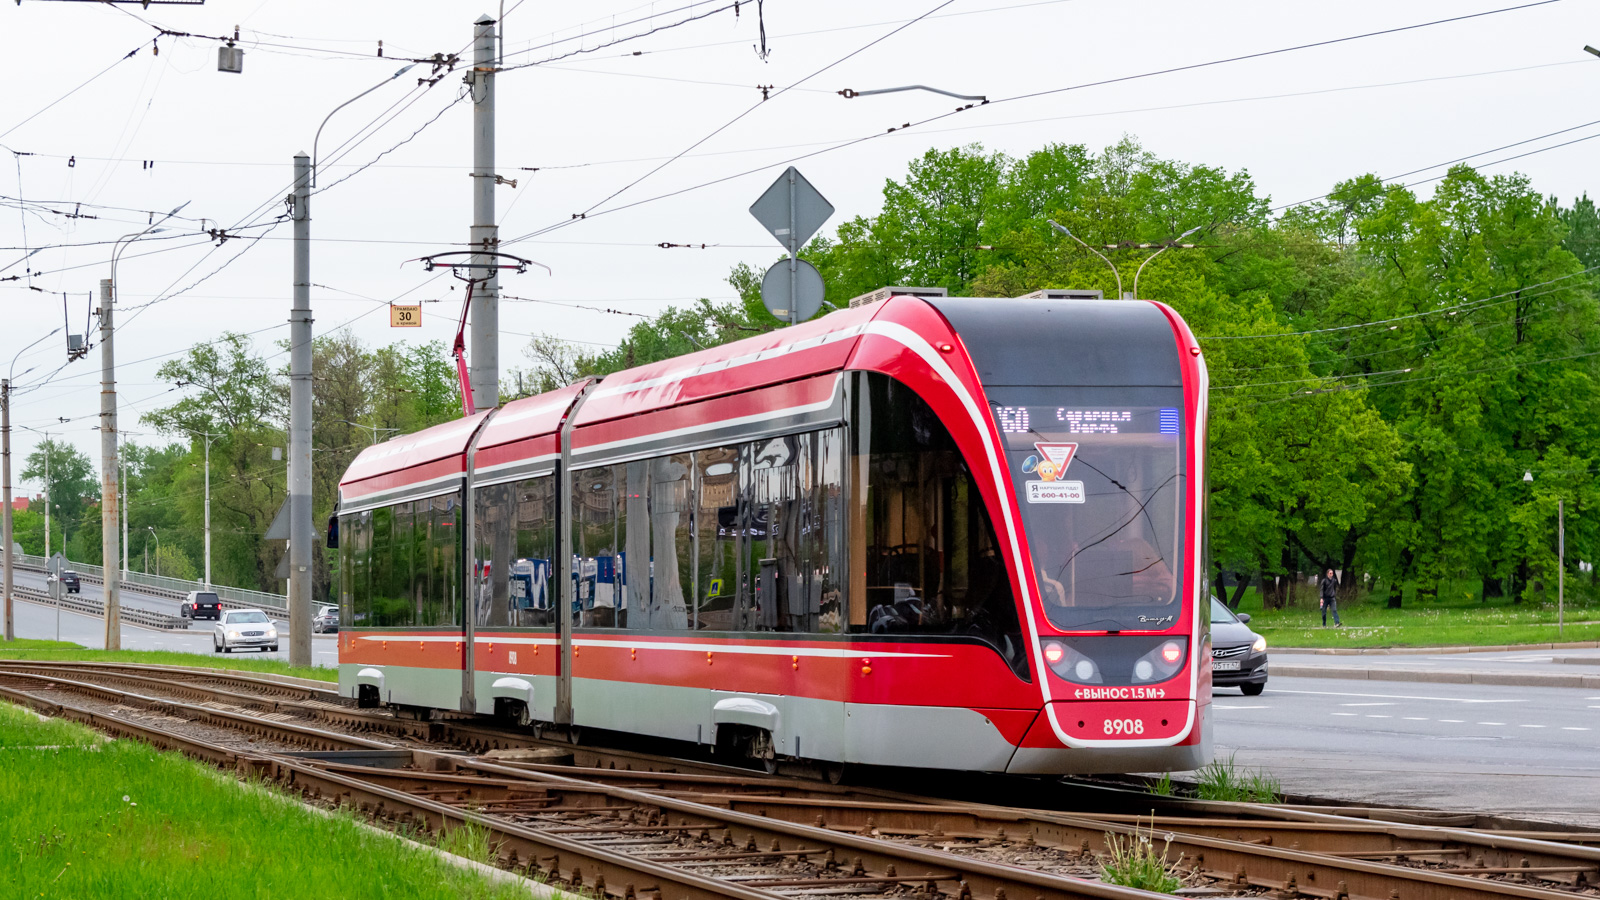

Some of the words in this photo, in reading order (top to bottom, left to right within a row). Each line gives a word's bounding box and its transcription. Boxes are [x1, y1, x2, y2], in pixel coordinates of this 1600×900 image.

[399, 312, 411, 321] 30
[1083, 688, 1129, 699] ВЫНОС
[1130, 688, 1145, 699] 1.5
[1146, 688, 1157, 699] М
[1103, 719, 1144, 735] 8908
